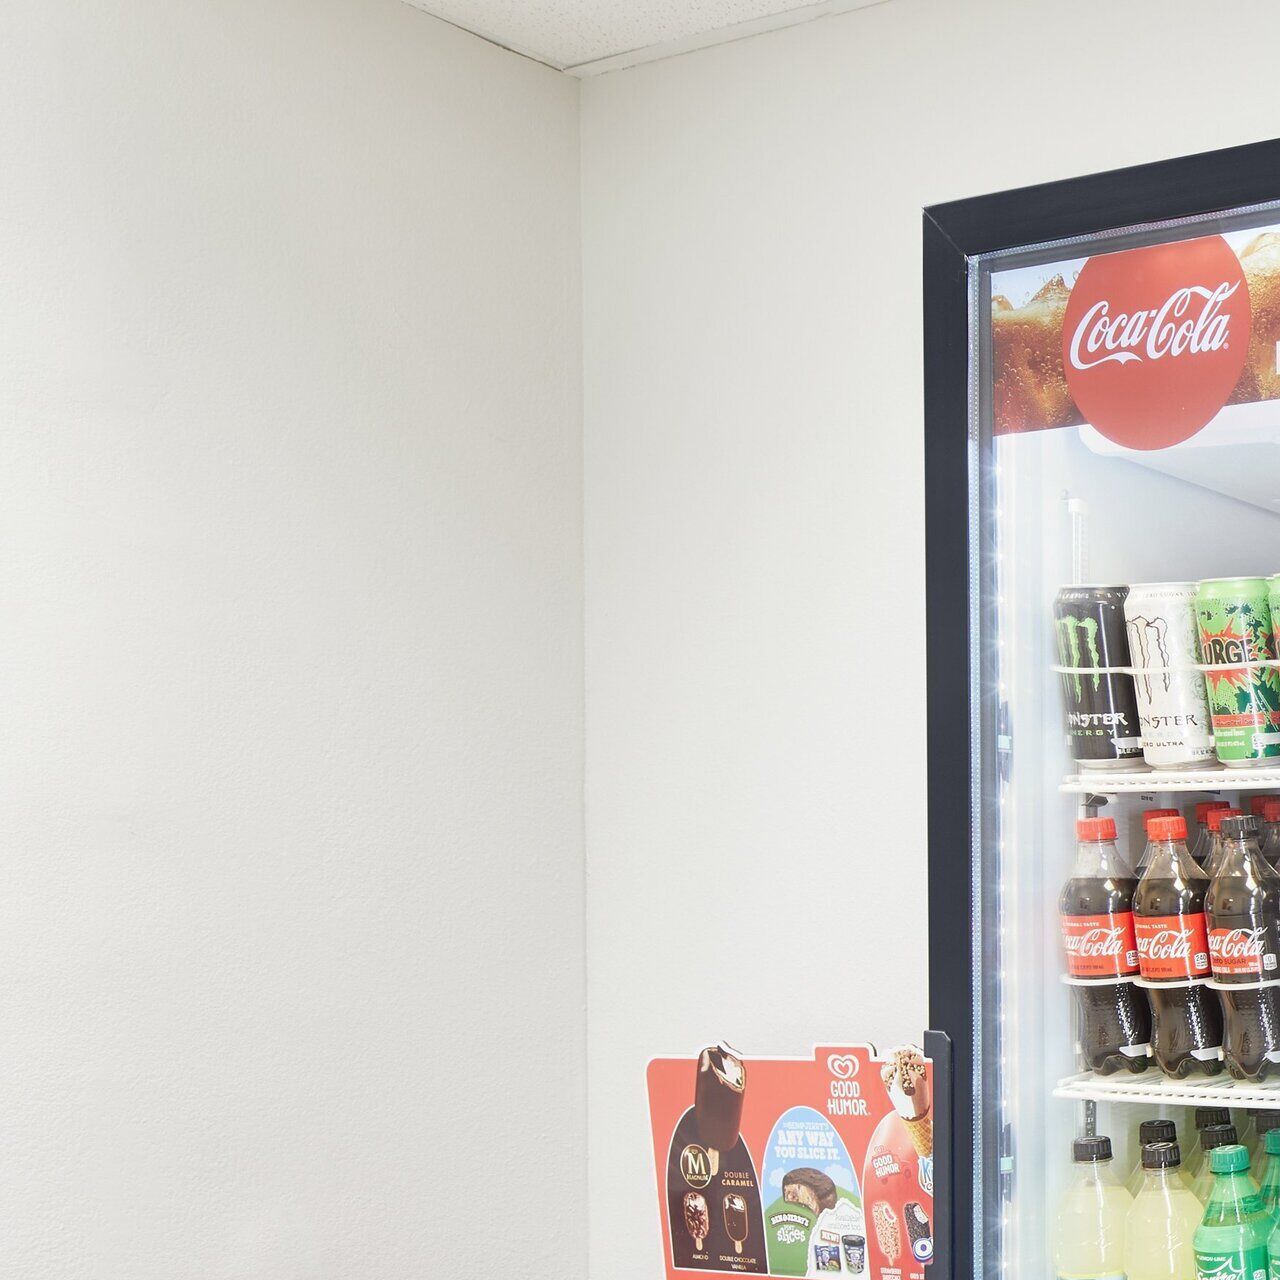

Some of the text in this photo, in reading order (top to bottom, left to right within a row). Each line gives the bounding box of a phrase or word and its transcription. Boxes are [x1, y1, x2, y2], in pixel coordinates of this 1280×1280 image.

[1069, 279, 1242, 370] Coca-Cola
[830, 1081, 860, 1097] GOOD
[827, 1099, 867, 1116] HUMOR
